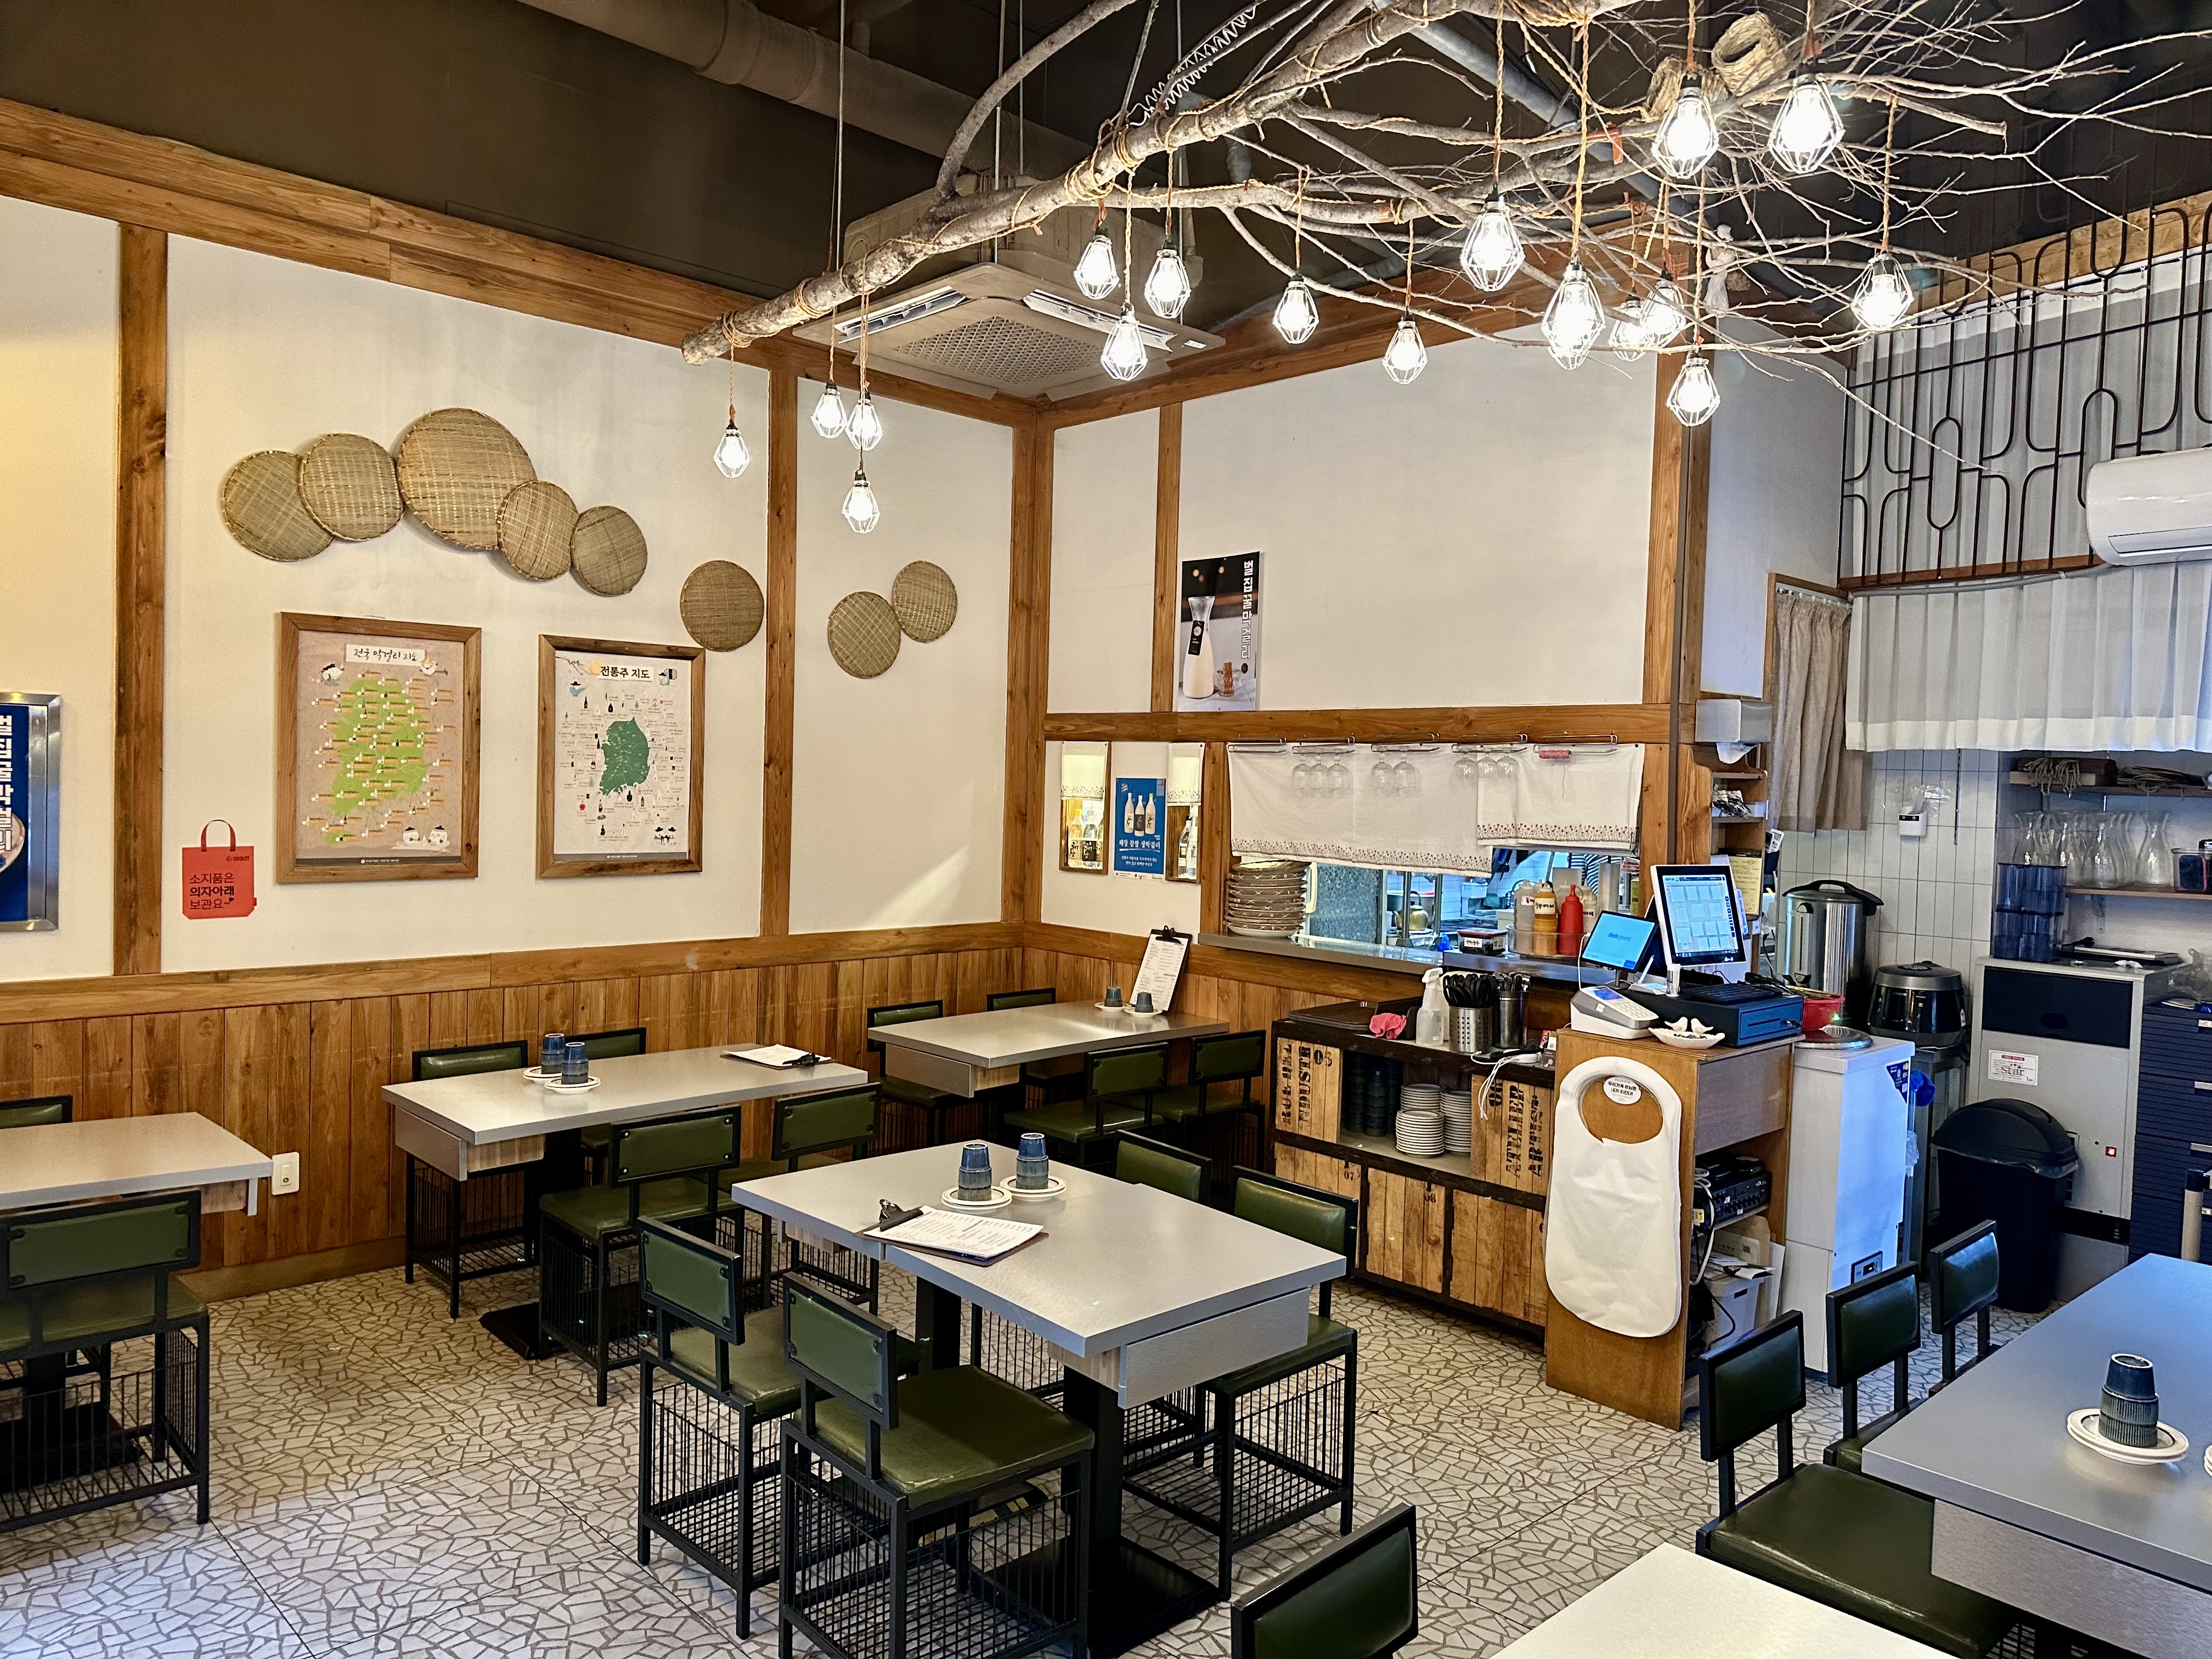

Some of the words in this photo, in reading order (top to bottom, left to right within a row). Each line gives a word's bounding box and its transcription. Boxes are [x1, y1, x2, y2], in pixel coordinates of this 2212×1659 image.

[354, 648, 370, 661] 전국
[373, 648, 400, 662] 막걸리
[403, 653, 417, 662] 지도
[600, 665, 629, 678] 전통주
[631, 668, 650, 679] 지도
[1141, 840, 1160, 849] 생막걸리
[189, 872, 234, 884] 소지품은
[189, 885, 234, 898] 의자아래
[2001, 1065, 2024, 1076] Star
[1505, 1085, 1524, 1179] ATELIER
[1344, 1170, 1354, 1181] 07
